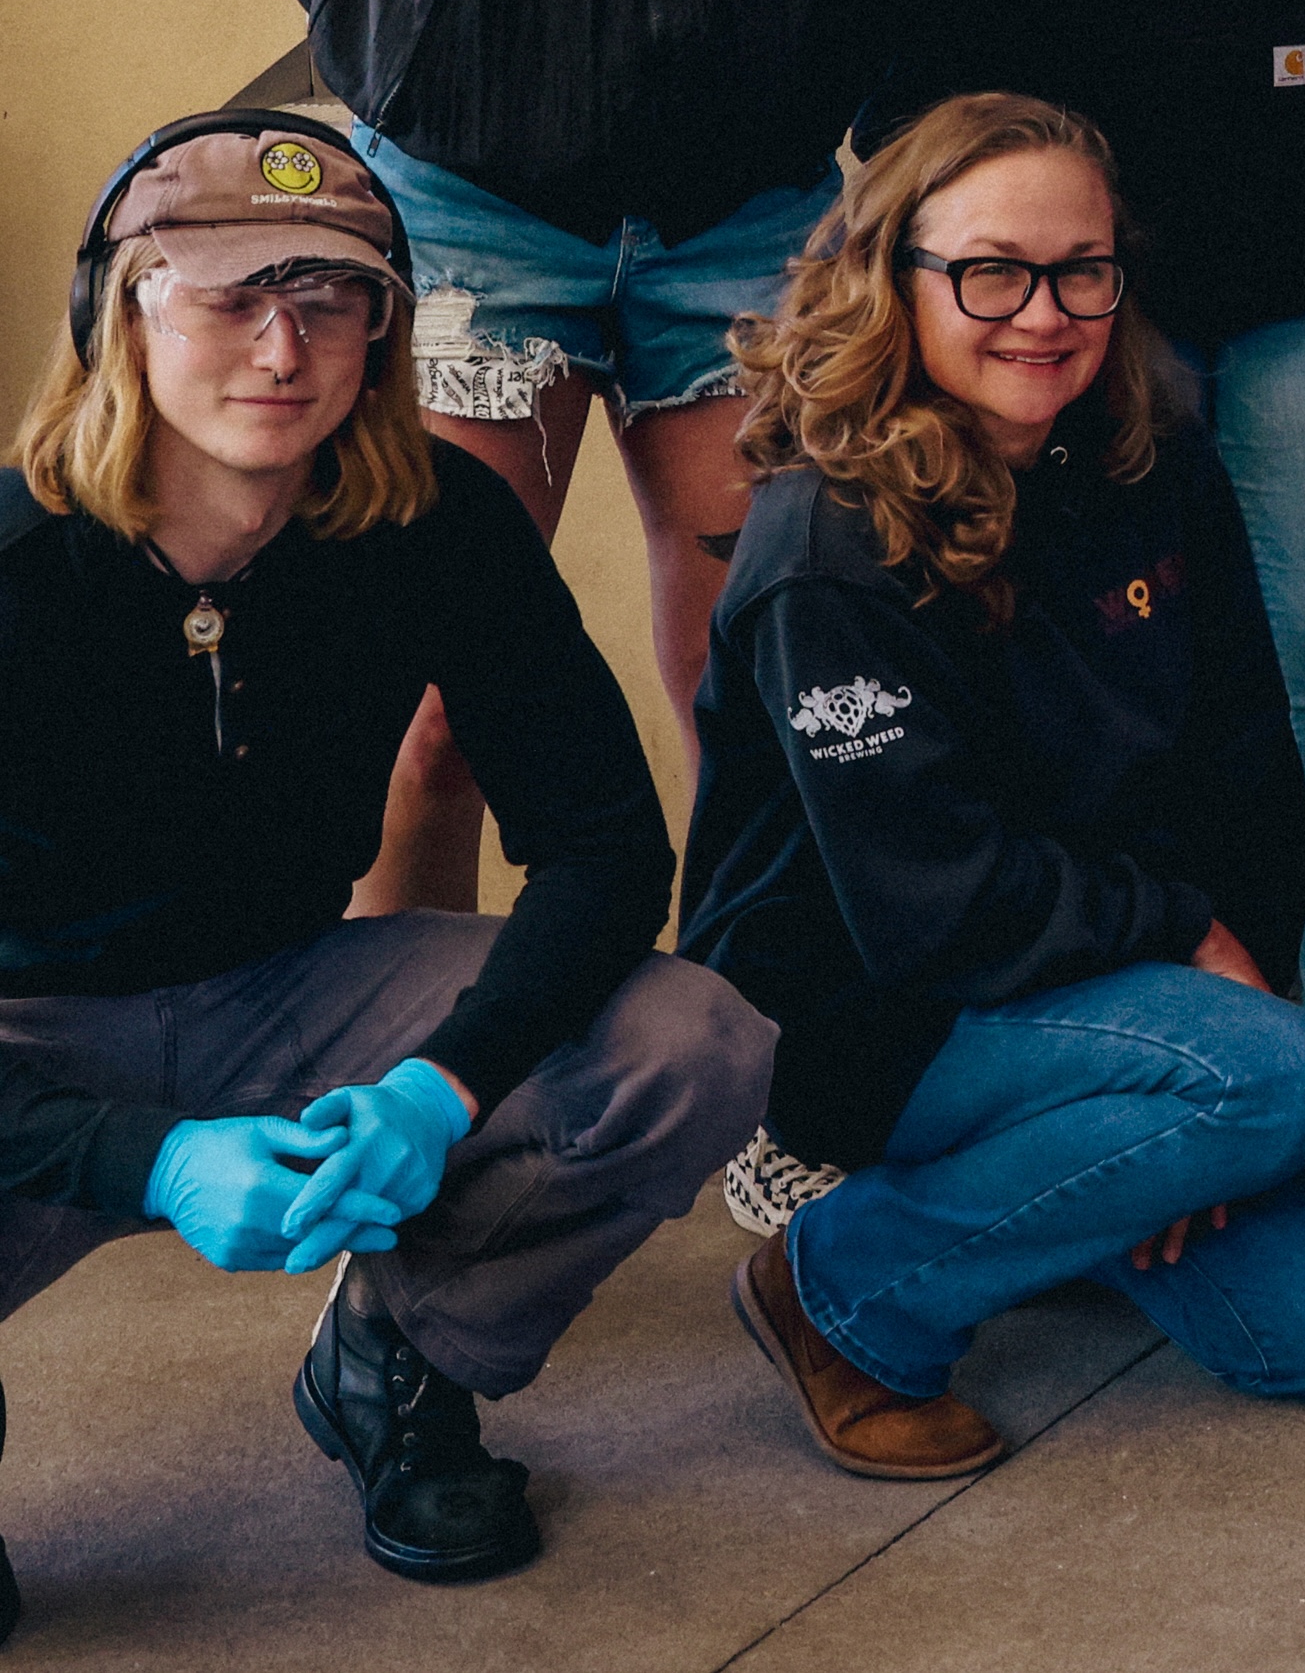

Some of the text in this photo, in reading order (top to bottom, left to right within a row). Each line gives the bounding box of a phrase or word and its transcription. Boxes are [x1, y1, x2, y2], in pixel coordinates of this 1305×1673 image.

[810, 727, 905, 760] WICKED WEED
[838, 746, 883, 764] BREWING
